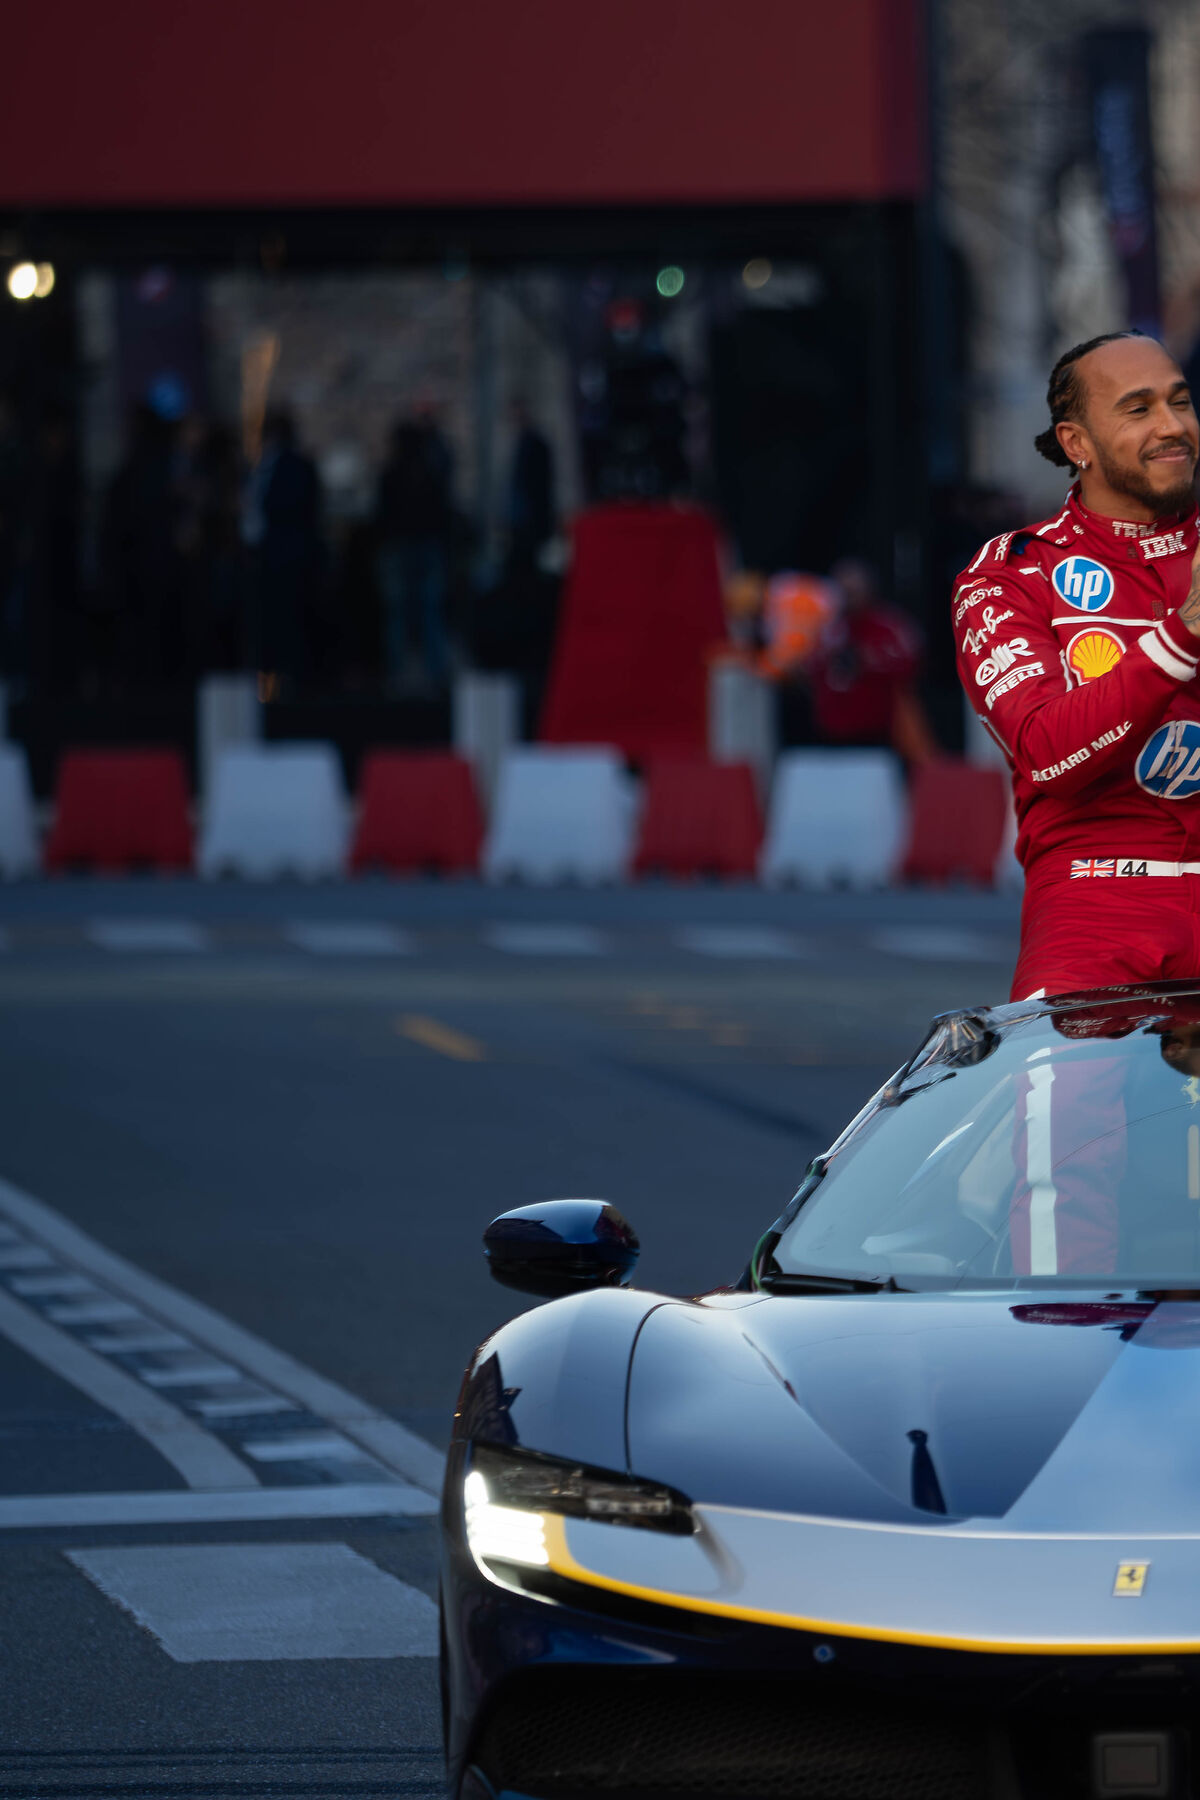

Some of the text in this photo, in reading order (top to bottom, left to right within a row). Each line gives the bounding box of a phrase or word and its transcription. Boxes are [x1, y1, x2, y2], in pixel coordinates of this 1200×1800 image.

[1139, 531, 1187, 559] IBM
[956, 586, 1003, 621] GENESYS
[985, 661, 1046, 711] PIRELLI
[1120, 861, 1149, 877] 44
